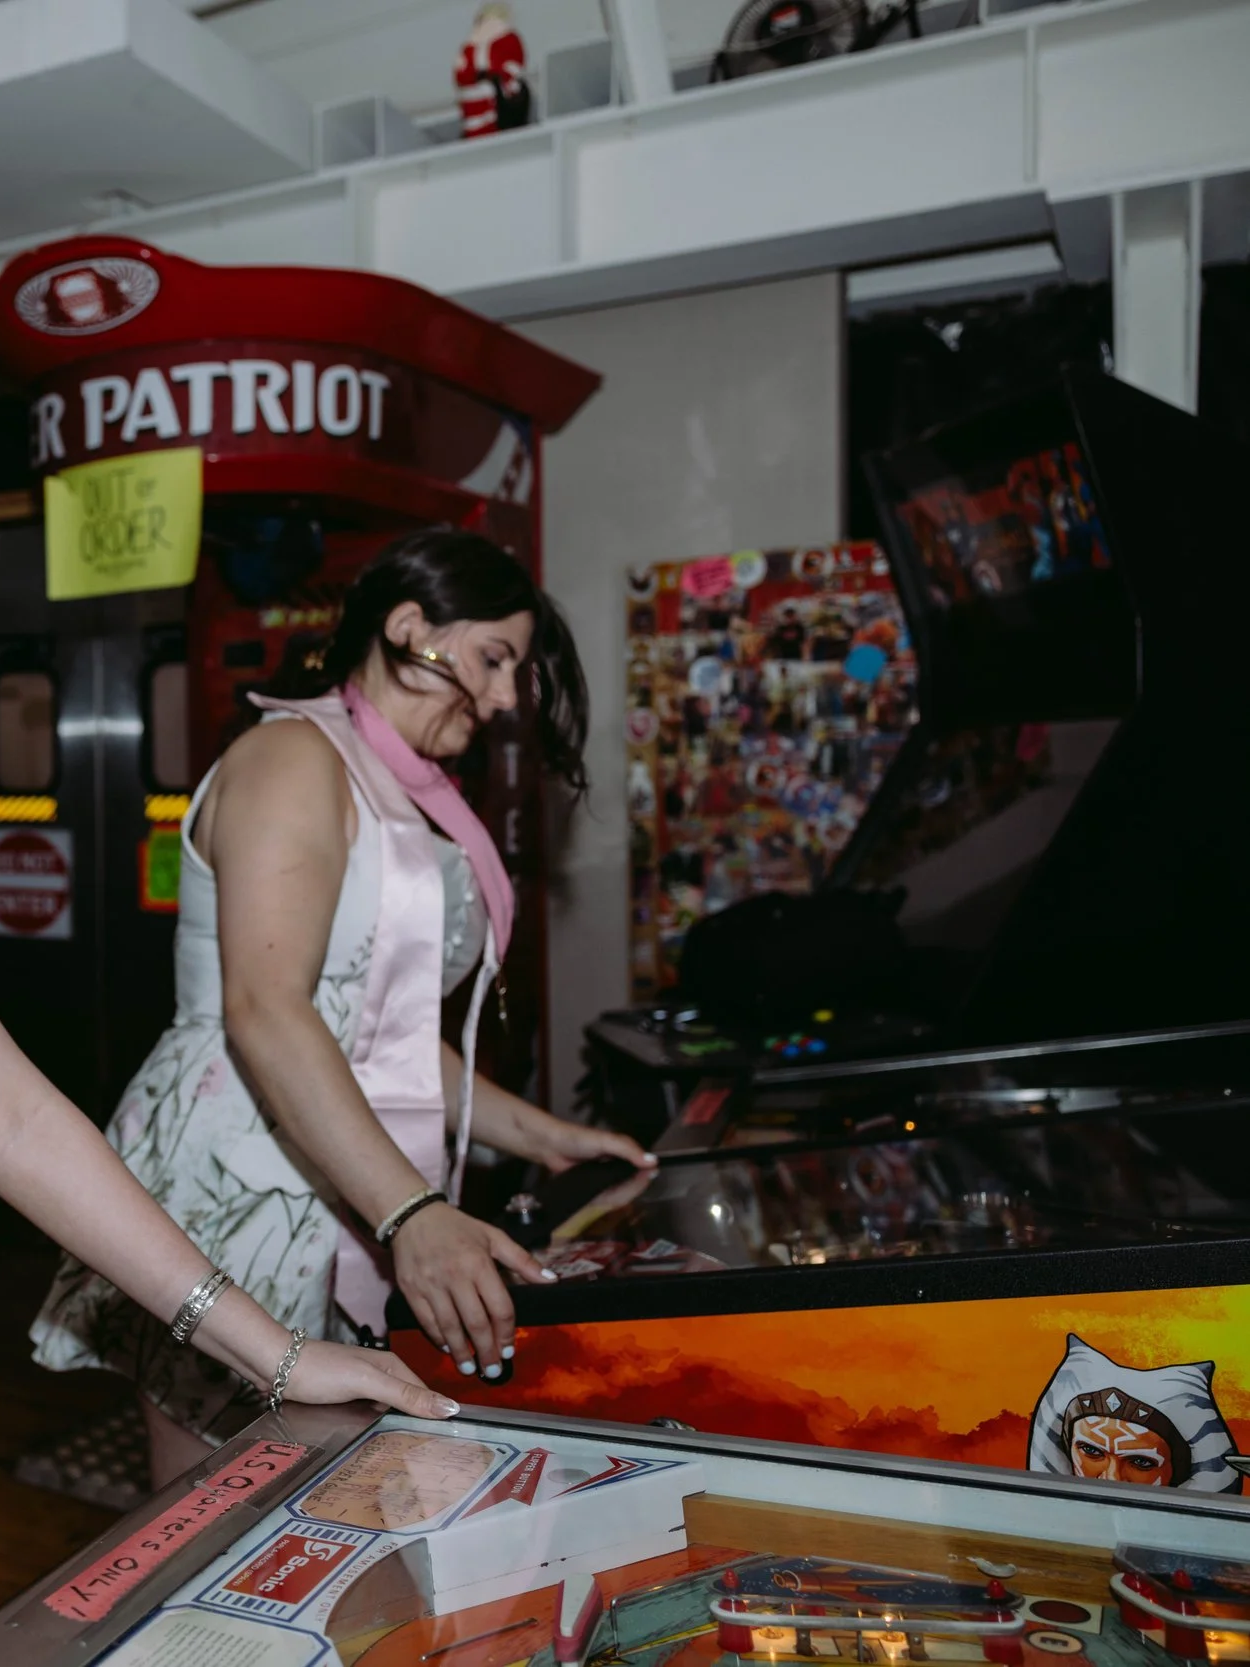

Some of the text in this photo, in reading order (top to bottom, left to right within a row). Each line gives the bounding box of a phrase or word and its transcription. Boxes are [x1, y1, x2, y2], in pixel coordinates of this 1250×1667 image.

[33, 359, 392, 466] R PATRIOT
[82, 467, 134, 518] OUT
[78, 504, 173, 564] ORDER
[343, 1445, 385, 1468] BALLS
[509, 1452, 542, 1495] FLIPPER BUTTON
[141, 1475, 255, 1551] Quarters
[305, 1482, 340, 1501] GAME
[376, 1541, 398, 1554] FOR
[257, 1554, 311, 1594] Sonic
[326, 1555, 376, 1599] AMUSEMENT
